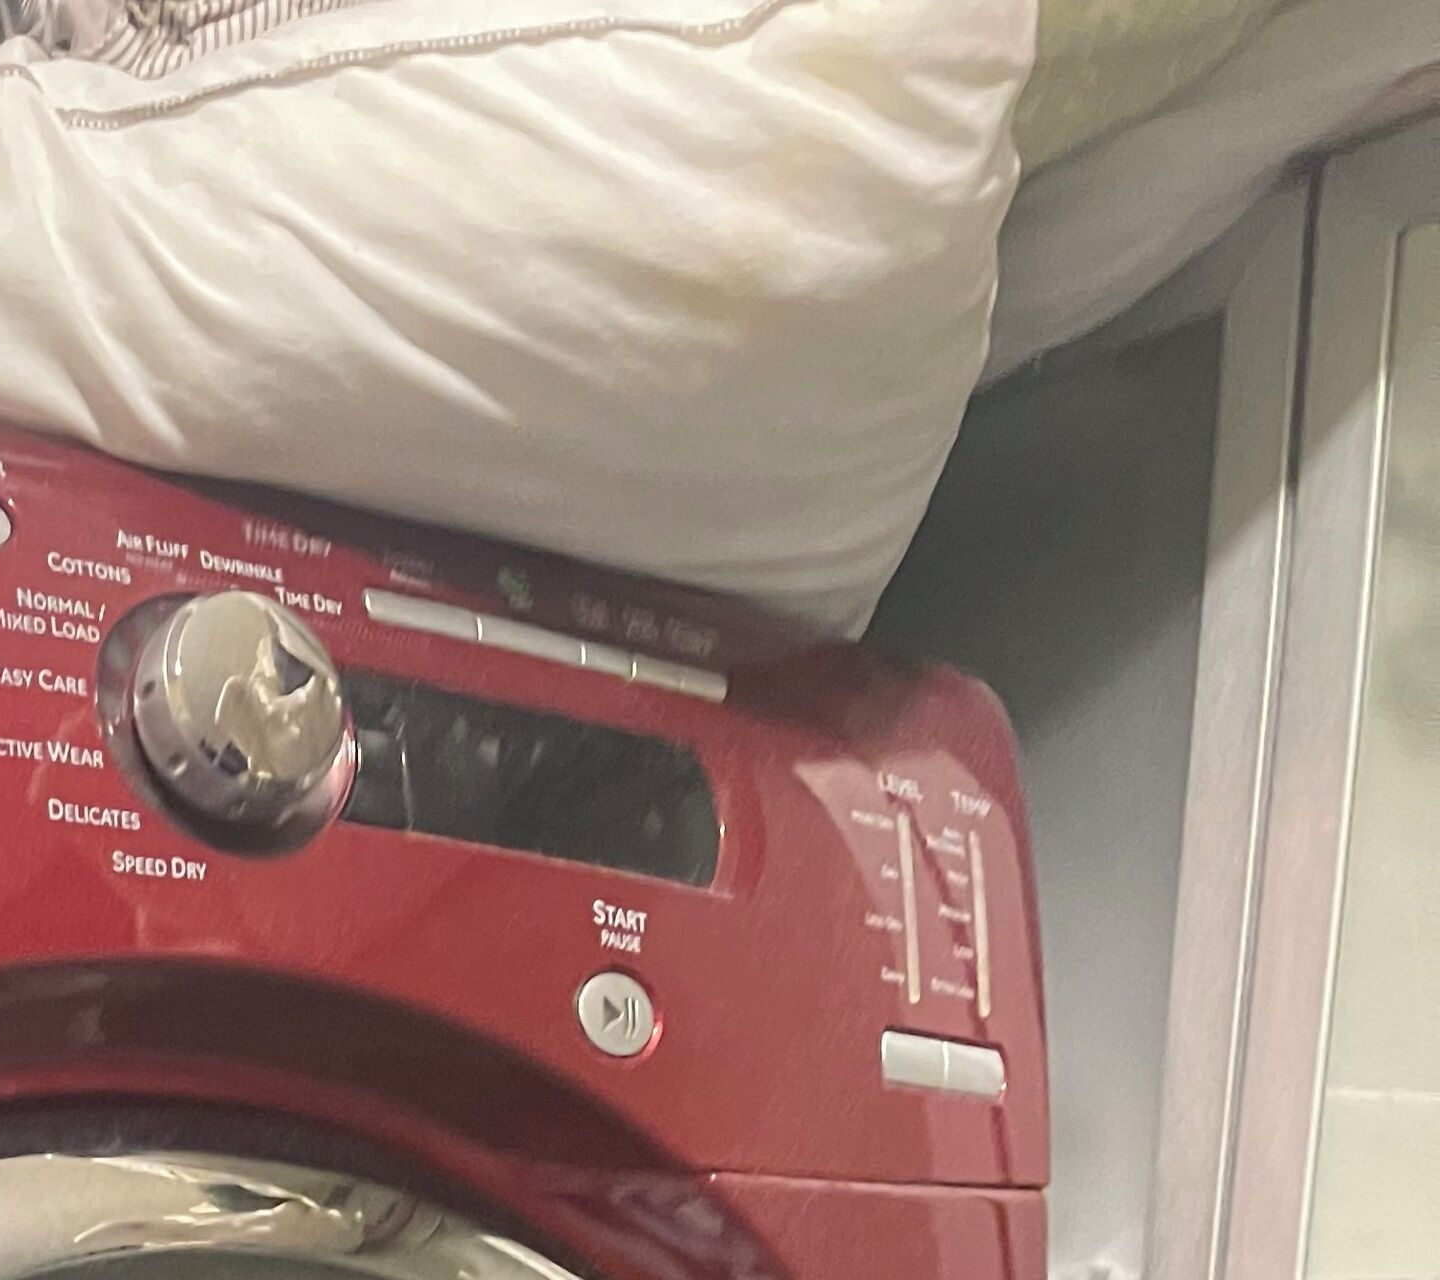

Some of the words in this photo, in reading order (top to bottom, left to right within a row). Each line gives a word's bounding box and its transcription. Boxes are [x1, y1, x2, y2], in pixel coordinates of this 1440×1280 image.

[117, 529, 142, 549] AIR
[145, 534, 189, 559] FLUFF
[243, 521, 289, 550] TIME
[293, 529, 332, 557] DRY
[47, 551, 132, 585] COTTONS
[199, 550, 284, 583] DEWRINKLE
[16, 587, 95, 619] NORMAL
[275, 586, 310, 610] TIME
[313, 593, 343, 616] DRY
[50, 618, 101, 643] LOAD
[38, 669, 88, 697] CARE
[47, 740, 104, 769] WEAR
[48, 798, 141, 830] DELICATES
[112, 850, 167, 877] SPEED
[171, 856, 207, 881] DRY
[593, 899, 647, 933] START
[601, 928, 641, 953] PAUSE
